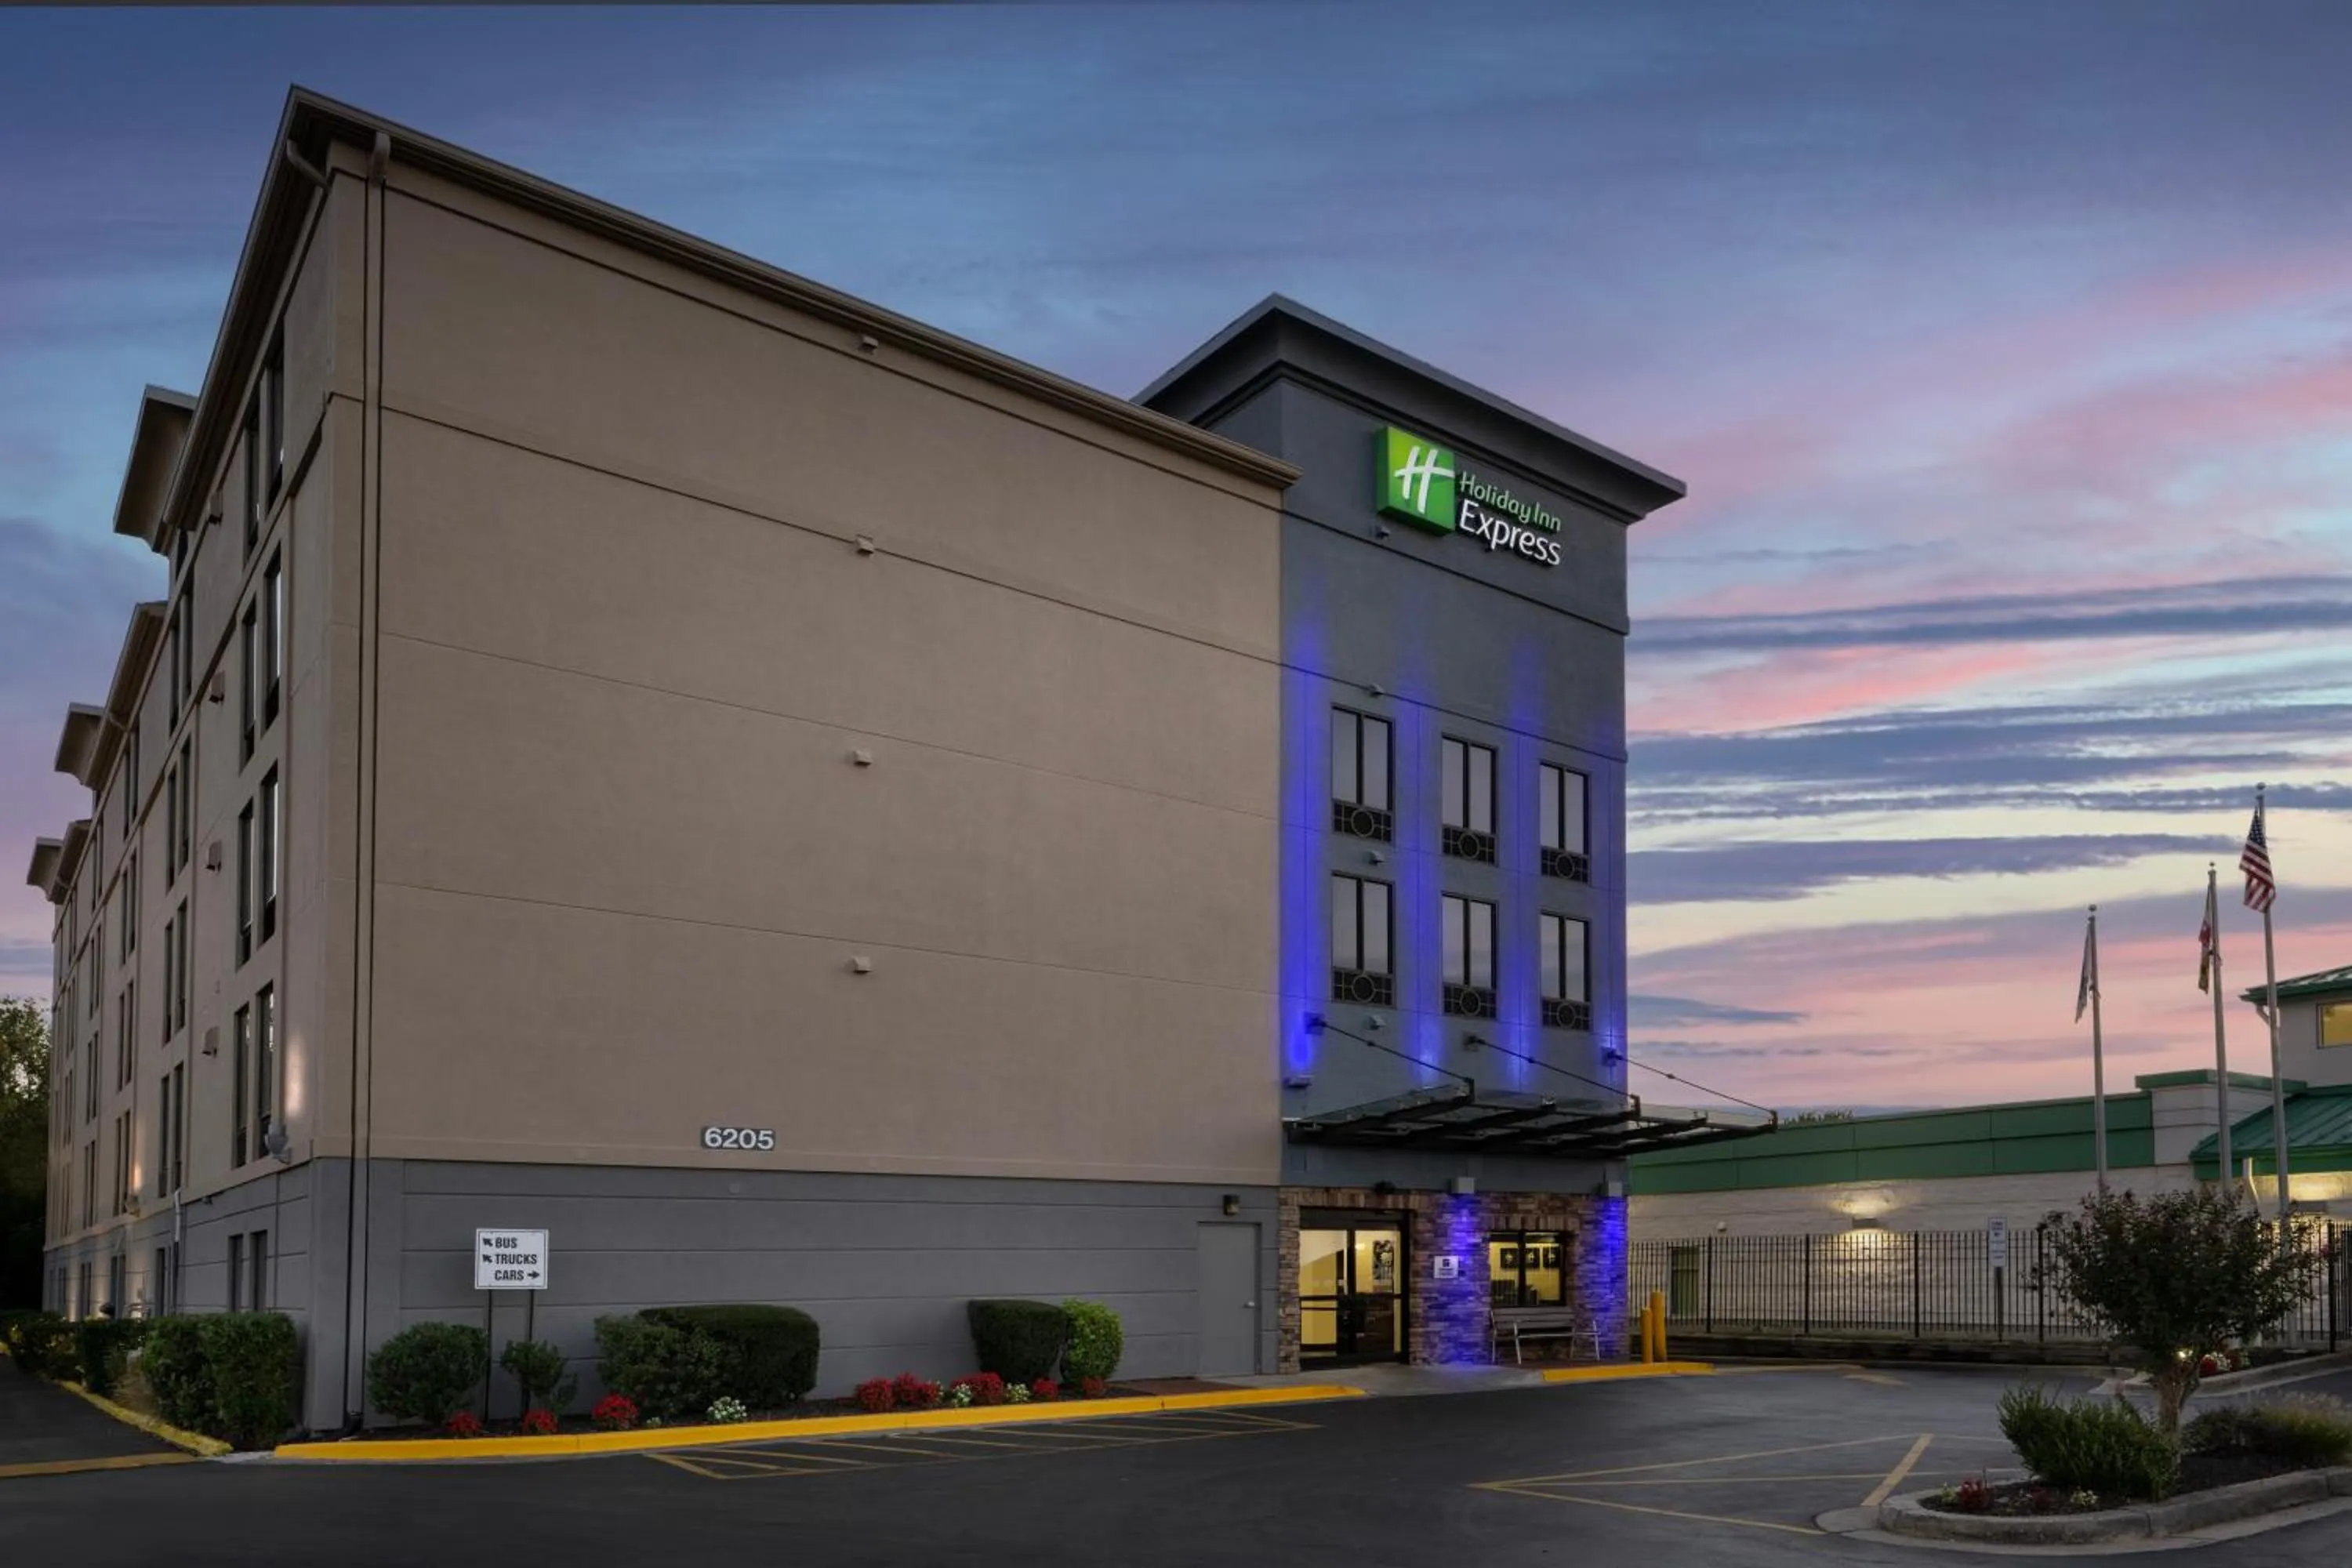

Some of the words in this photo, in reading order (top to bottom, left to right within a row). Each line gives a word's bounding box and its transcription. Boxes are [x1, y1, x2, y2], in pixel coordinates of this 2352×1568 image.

[1459, 470, 1531, 524] Holiday
[1533, 501, 1561, 532] Inn
[1459, 499, 1561, 565] Express
[705, 1127, 774, 1149] 6205
[495, 1237, 517, 1249] BUS
[495, 1254, 537, 1265] TRUCKS
[495, 1269, 524, 1281] CARS
